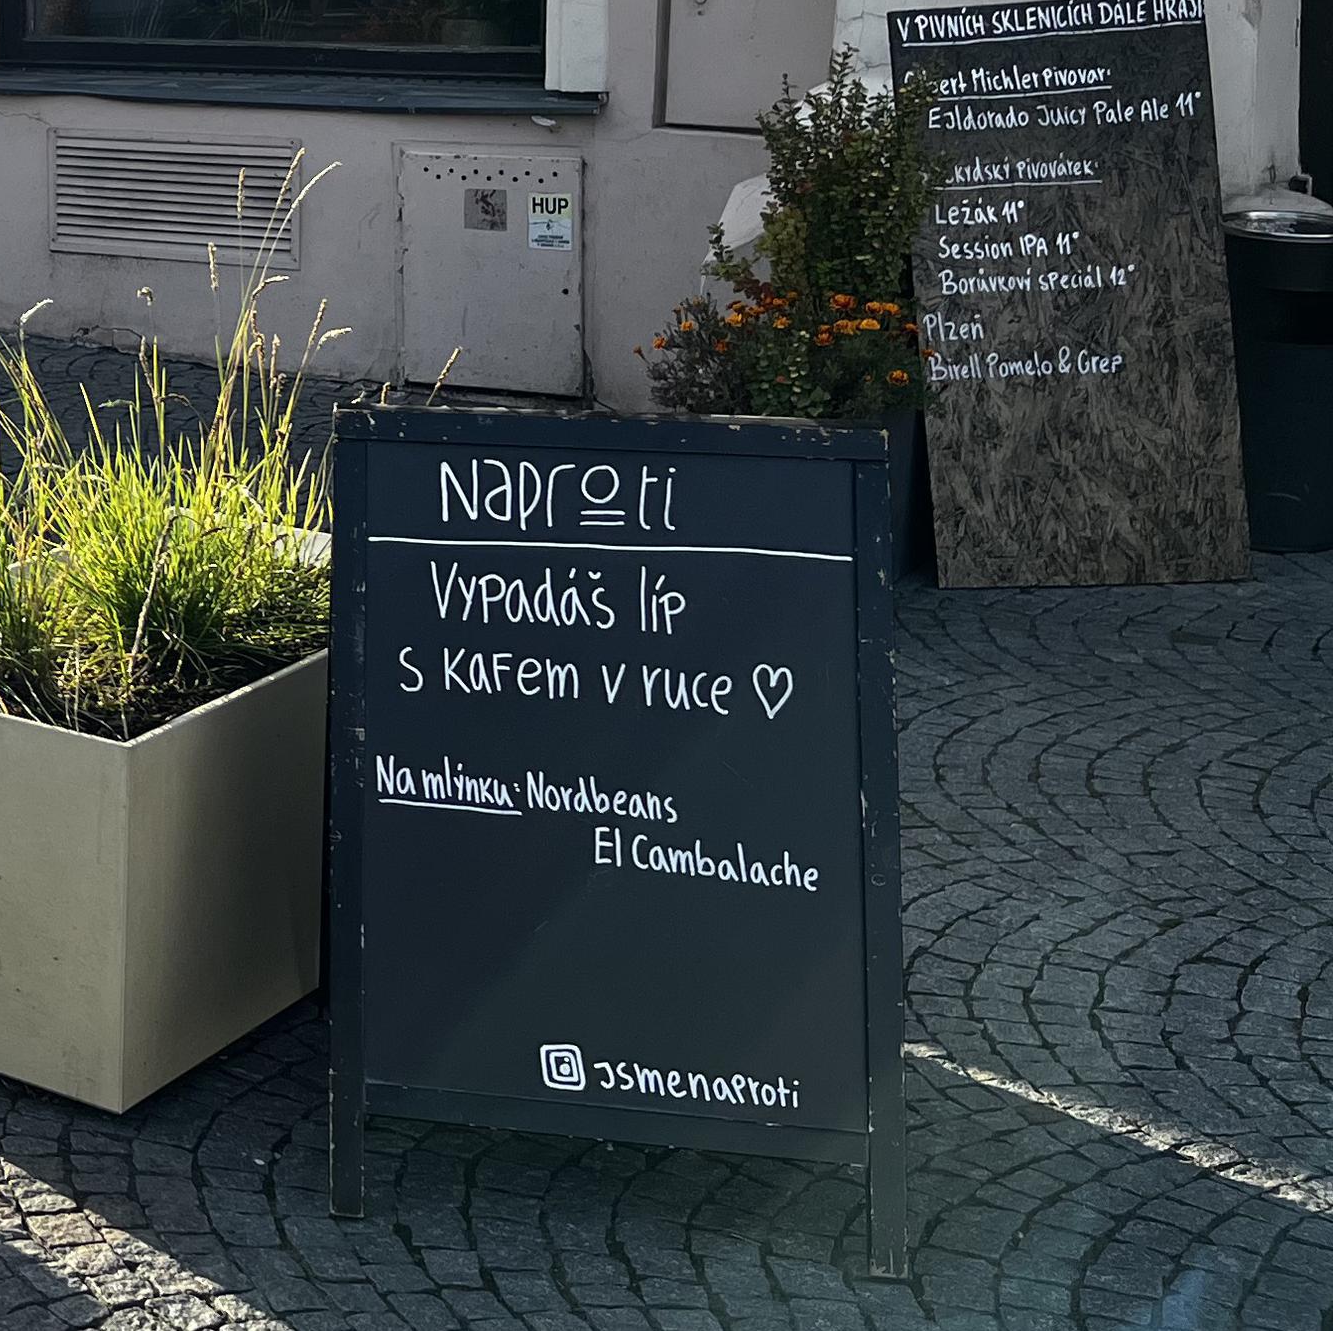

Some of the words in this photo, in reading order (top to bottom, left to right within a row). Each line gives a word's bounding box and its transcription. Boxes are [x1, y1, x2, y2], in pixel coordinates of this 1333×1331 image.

[896, 16, 910, 42] V
[914, 7, 985, 41] PIVNÍCH
[991, 0, 1094, 34] SKLENICÍCH
[971, 64, 1039, 93] Michler
[1092, 99, 1135, 125] Pale
[1140, 98, 1170, 122] Ale
[532, 196, 569, 215] HUP
[935, 197, 999, 225] Ležák
[938, 235, 1014, 260] Session
[1019, 234, 1049, 257] IPA
[927, 351, 982, 381] Birell
[986, 351, 1053, 379] Pomelo
[1058, 345, 1072, 374] &
[430, 560, 615, 631] Vypadáš
[639, 565, 687, 636] líp
[642, 666, 733, 716] ruce
[375, 754, 416, 796] Na
[525, 770, 679, 823] Nordbeans
[594, 826, 622, 868] El
[631, 833, 820, 892] Cambalache
